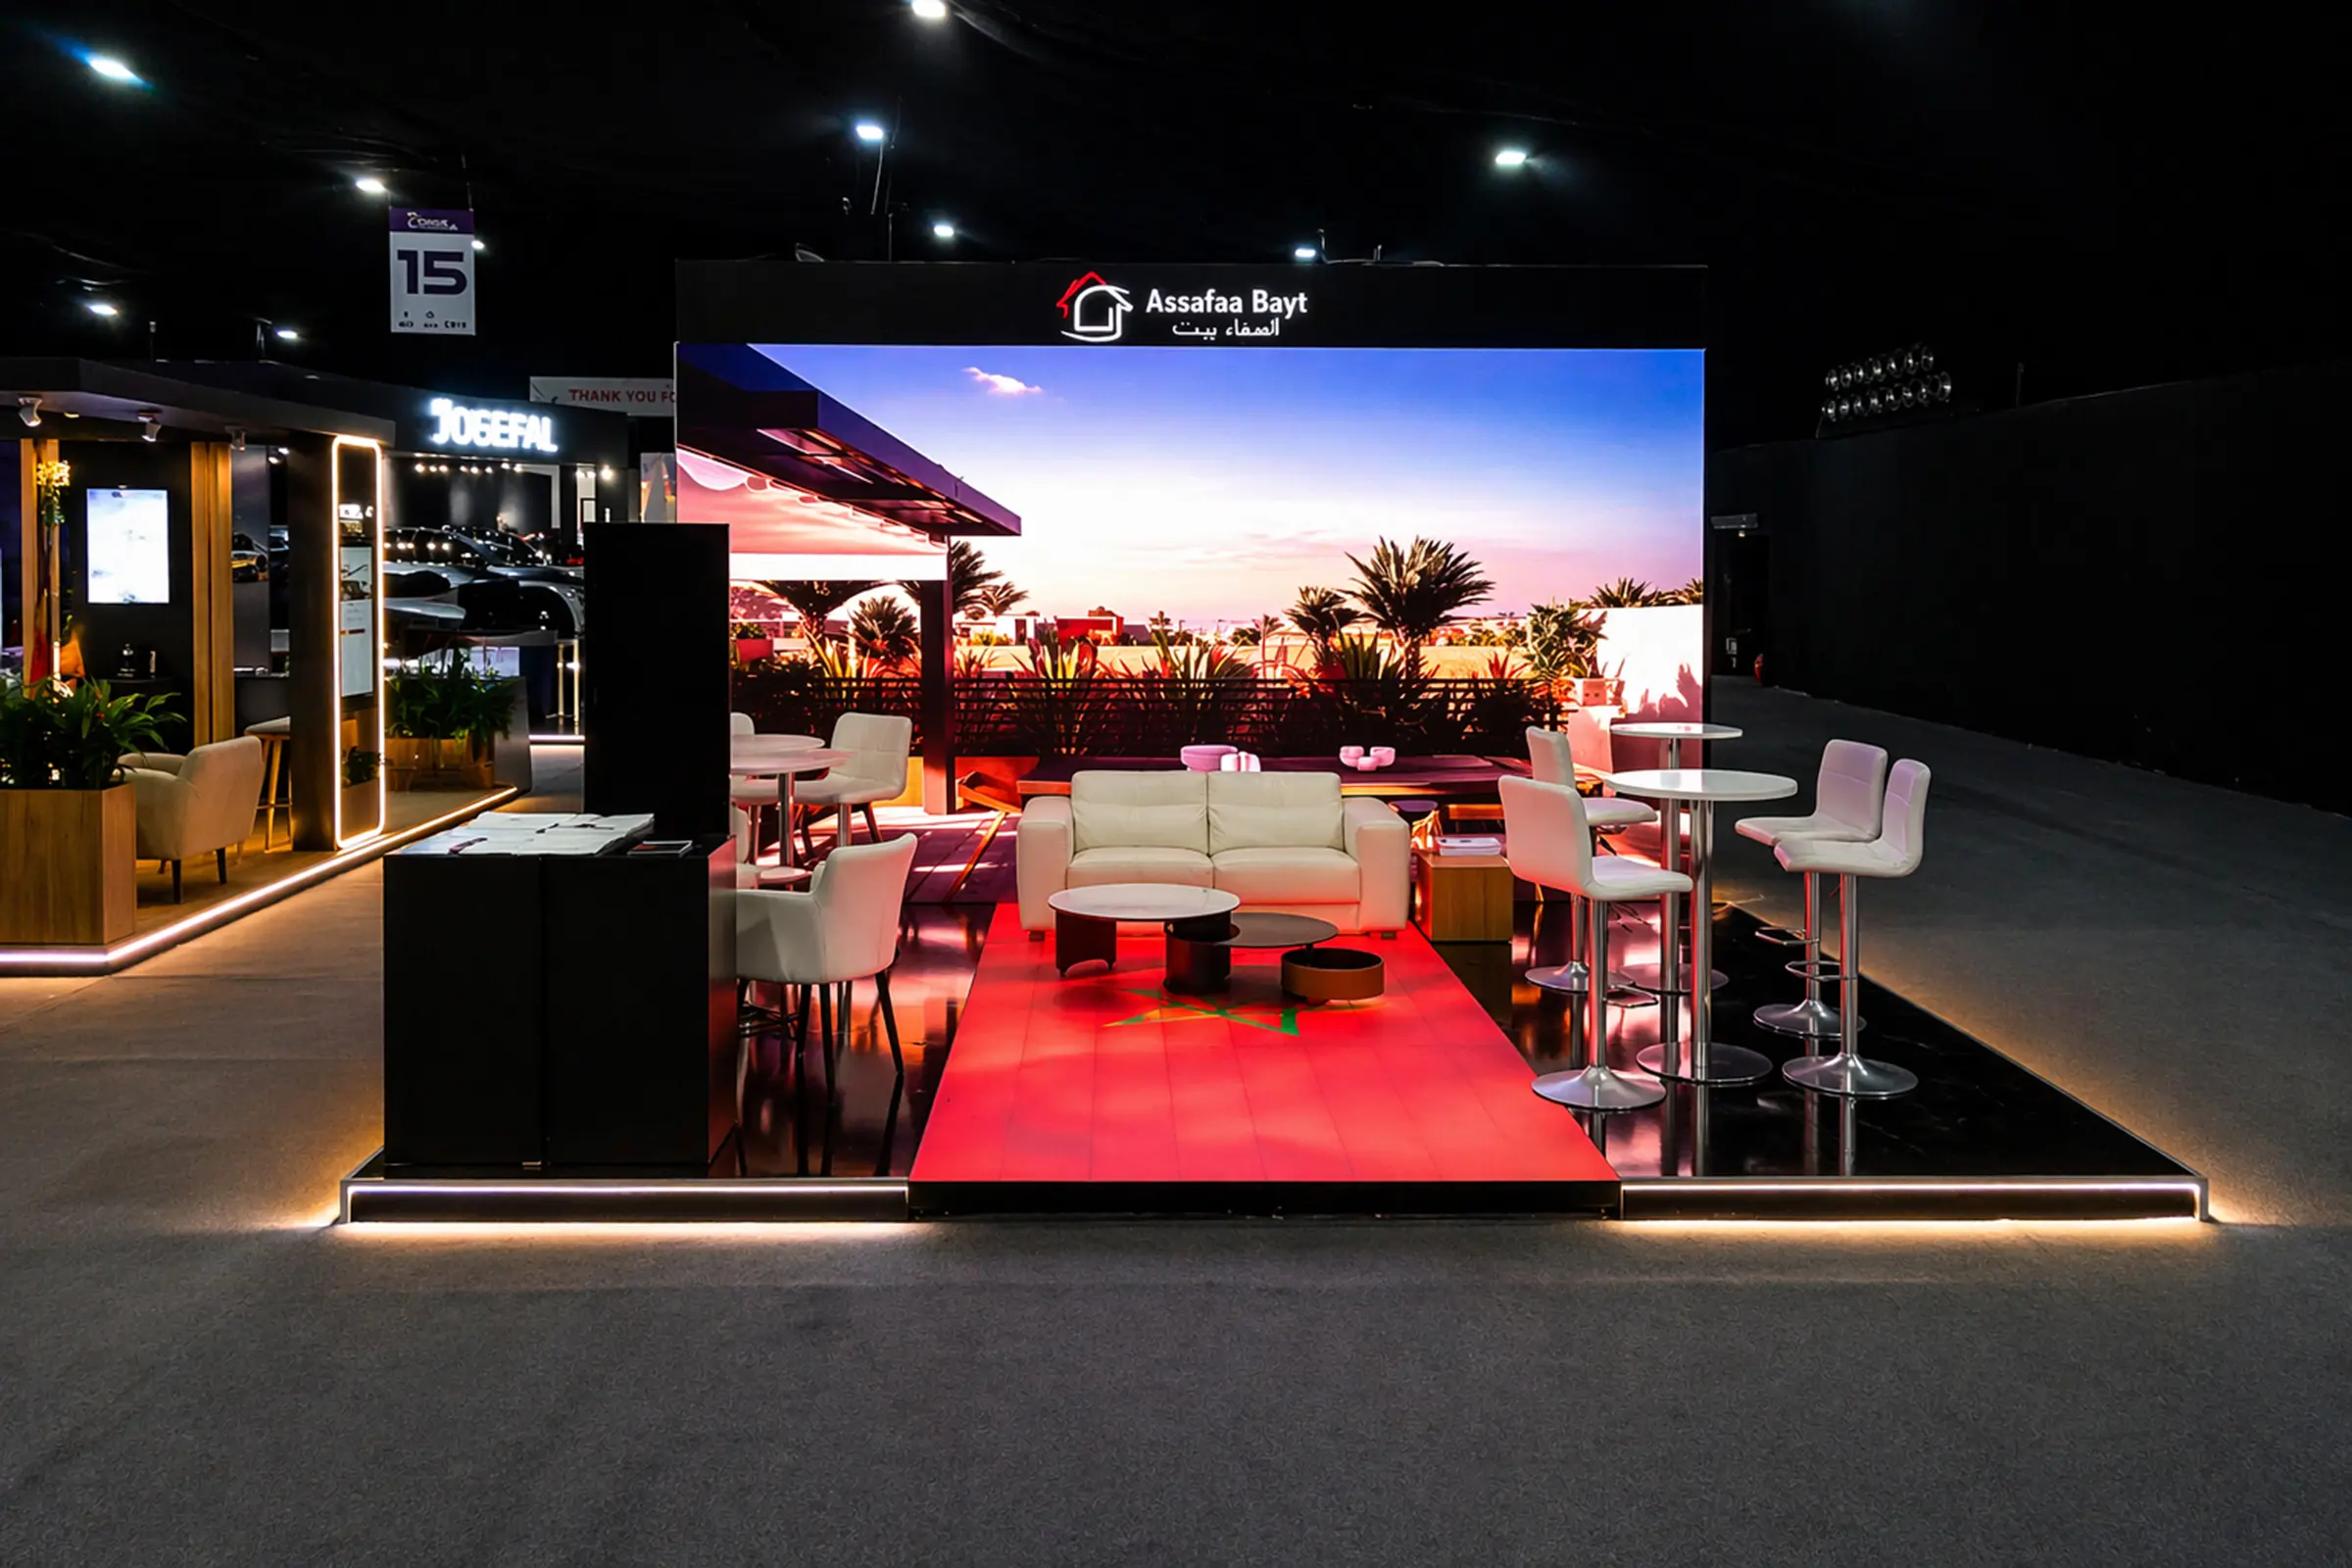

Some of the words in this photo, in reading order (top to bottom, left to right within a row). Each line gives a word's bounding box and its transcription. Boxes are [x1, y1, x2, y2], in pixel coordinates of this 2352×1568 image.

[397, 249, 467, 296] 15
[1146, 289, 1244, 314] Assafaa
[1251, 289, 1308, 319] Bayt
[1172, 321, 1217, 340] بيت
[1225, 317, 1280, 336] الصفاء
[568, 389, 621, 403] THANK
[625, 390, 657, 403] YOU
